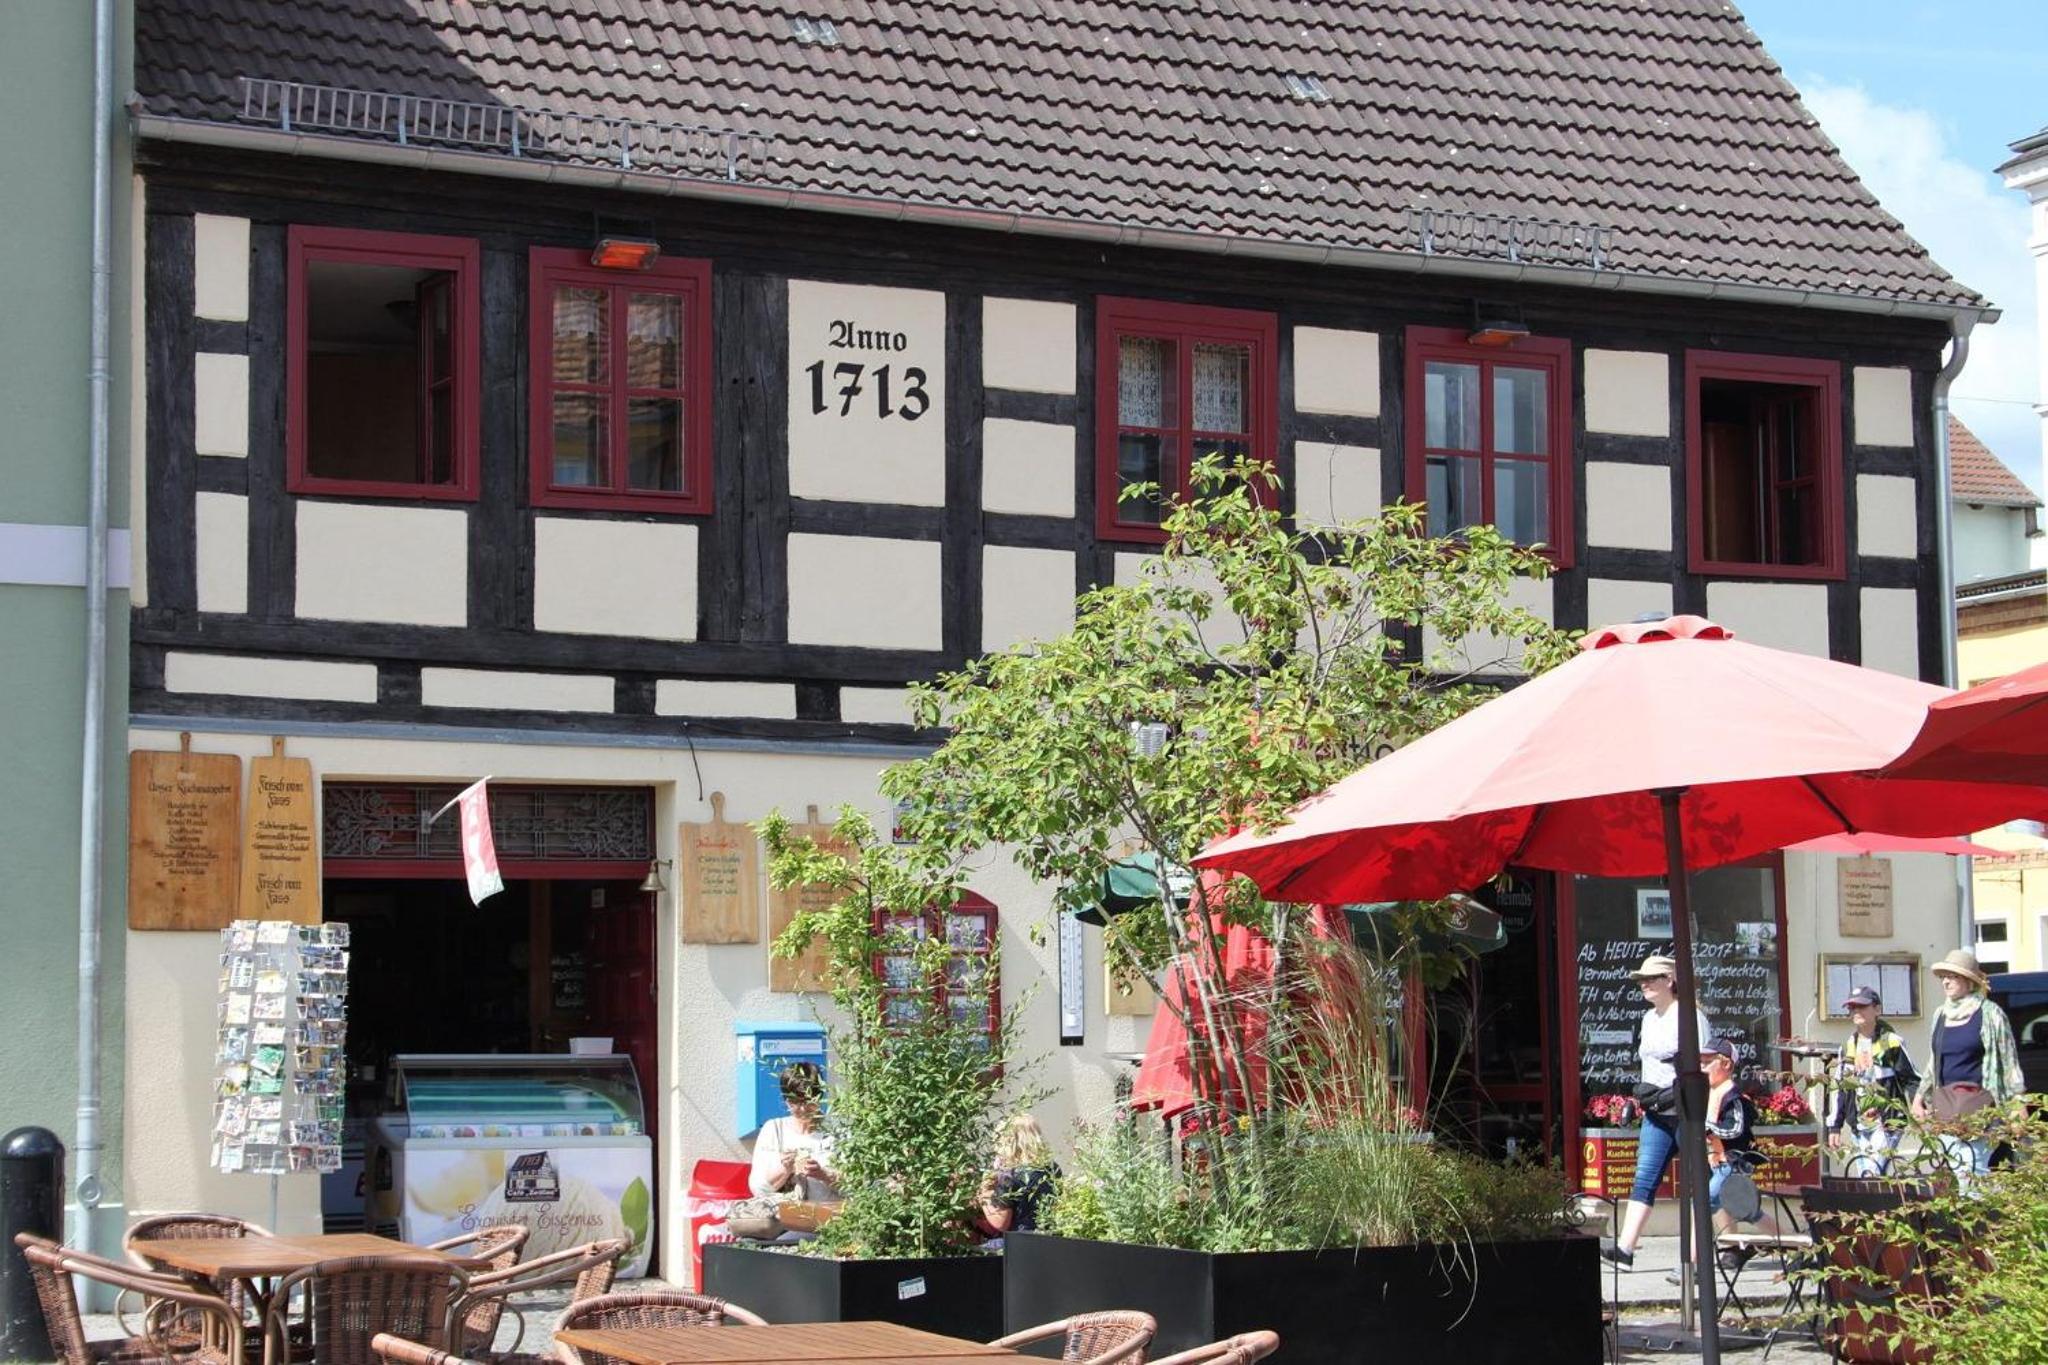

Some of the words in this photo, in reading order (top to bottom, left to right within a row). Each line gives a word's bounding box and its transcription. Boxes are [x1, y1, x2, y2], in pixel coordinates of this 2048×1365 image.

[828, 320, 908, 352] Anno
[805, 359, 930, 421] 1713
[1577, 943, 1597, 962] Ab
[1602, 940, 1650, 961] HEUTE
[1578, 965, 1634, 981] Vermietu
[1602, 984, 1626, 1002] auf
[535, 1202, 604, 1236] Eisgenuss
